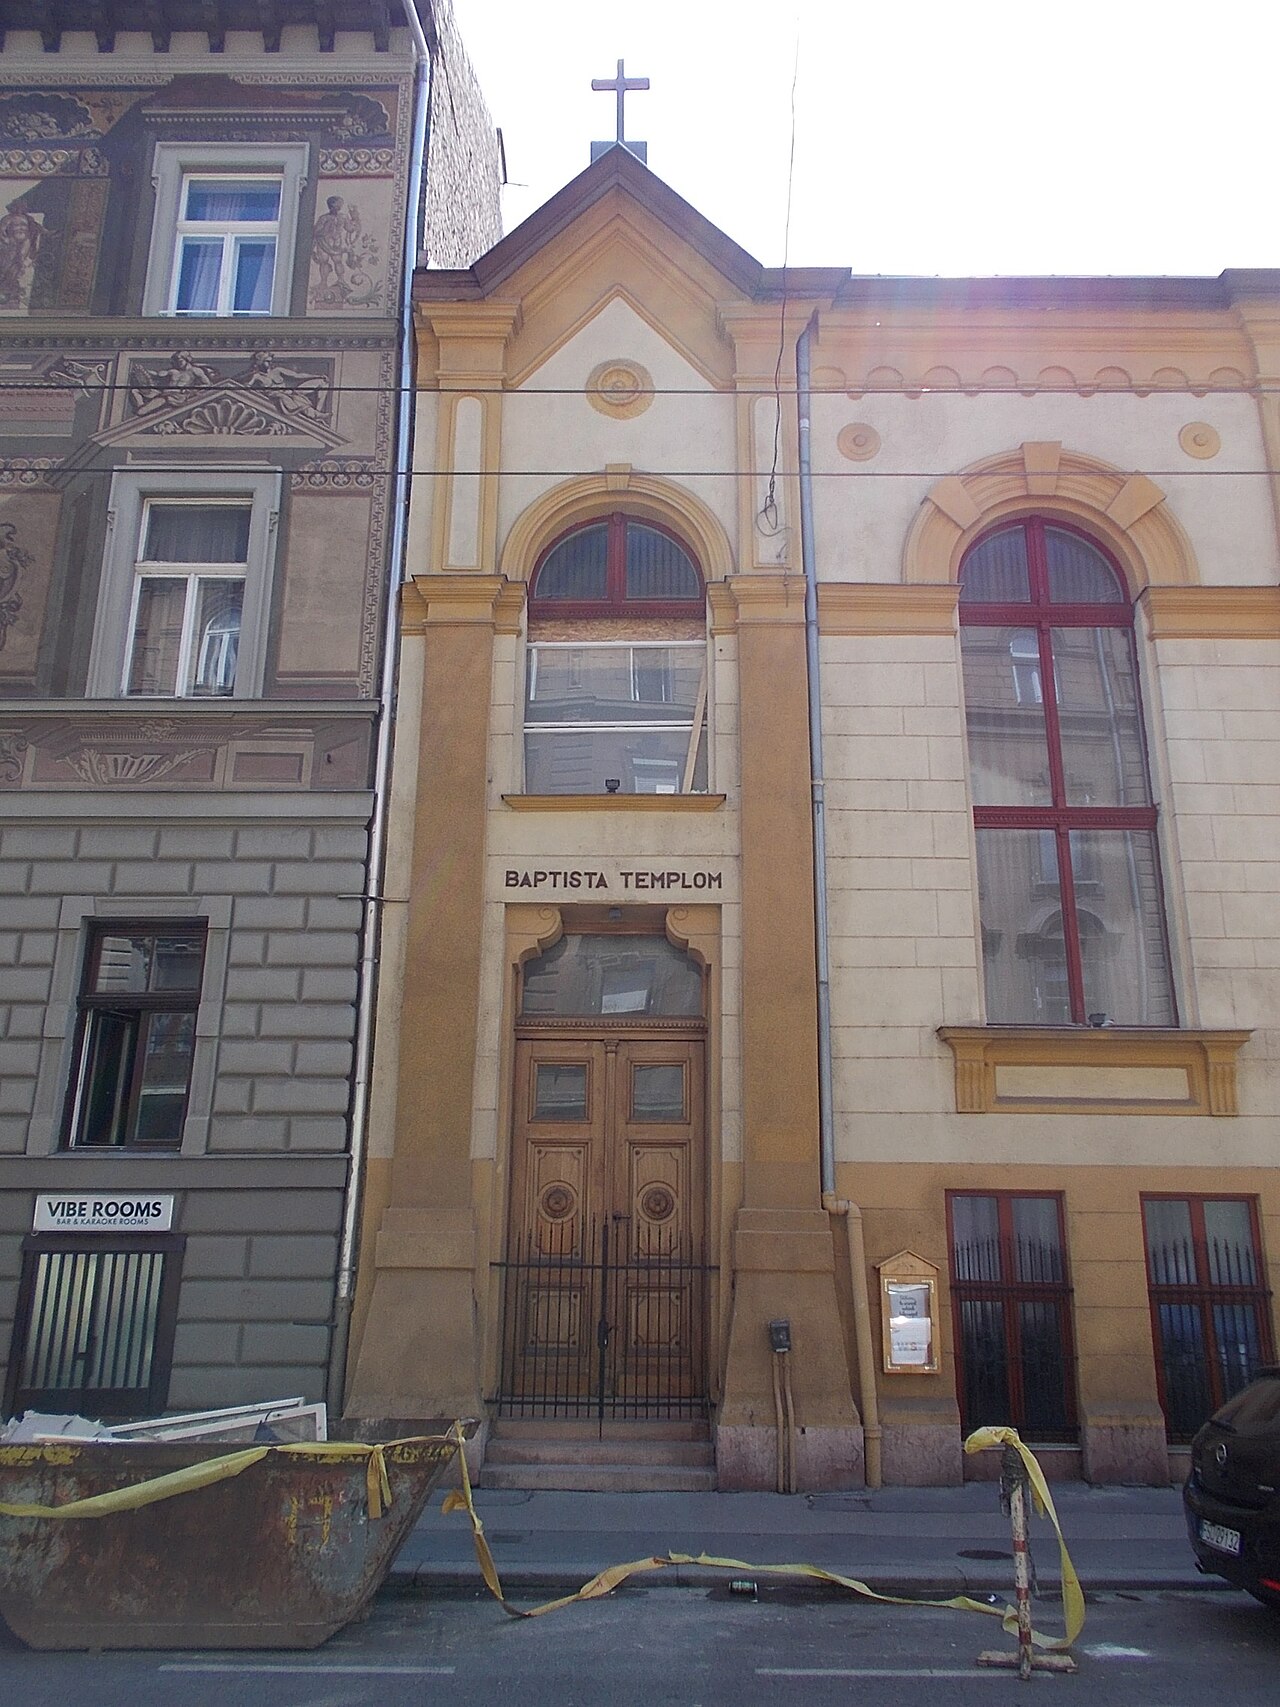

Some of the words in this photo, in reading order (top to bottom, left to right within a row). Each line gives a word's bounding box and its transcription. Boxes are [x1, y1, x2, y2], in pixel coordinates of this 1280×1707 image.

[505, 870, 608, 888] BAPTISTA
[620, 871, 722, 889] TEMPLOM
[47, 1201, 87, 1217] VIBE
[92, 1201, 162, 1218] ROOMS
[56, 1218, 71, 1226] BAR
[80, 1218, 117, 1226] KARAOKE
[119, 1218, 149, 1226] ROOMS
